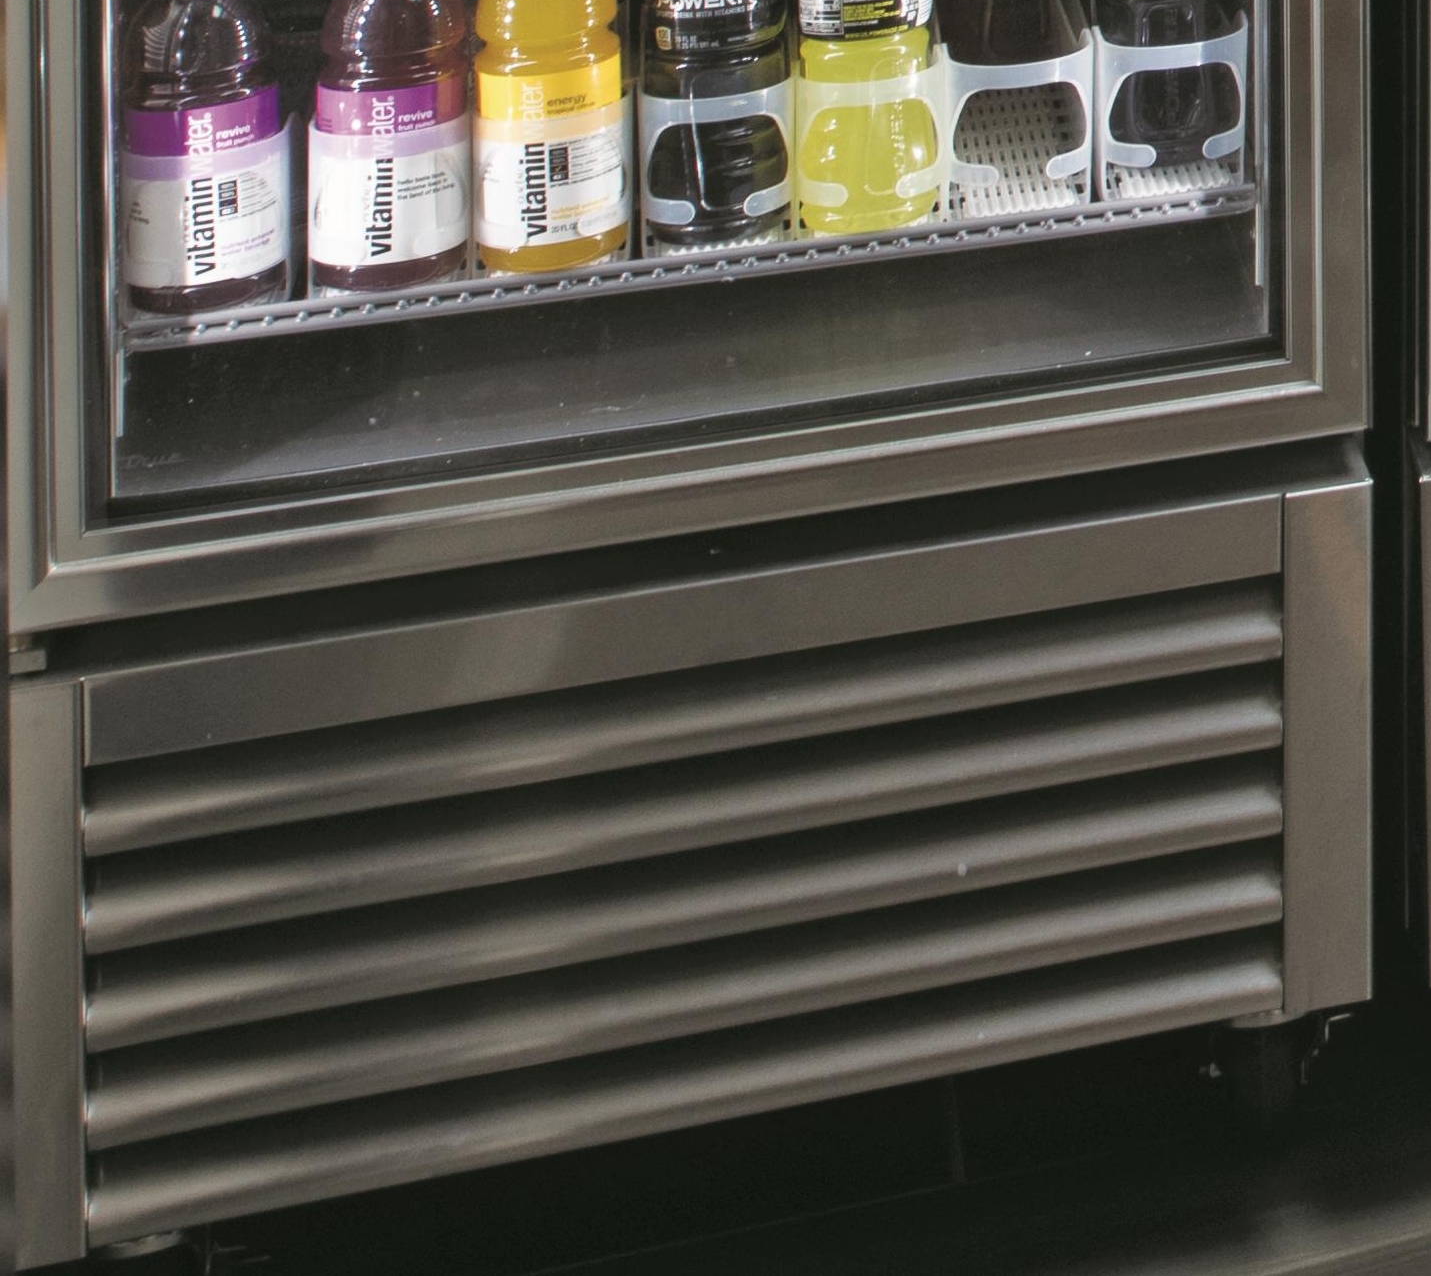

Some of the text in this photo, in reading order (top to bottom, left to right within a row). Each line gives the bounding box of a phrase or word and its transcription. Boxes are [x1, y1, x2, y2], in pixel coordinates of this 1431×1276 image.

[546, 92, 588, 109] energy
[398, 109, 434, 125] revive
[215, 124, 251, 141] revive
